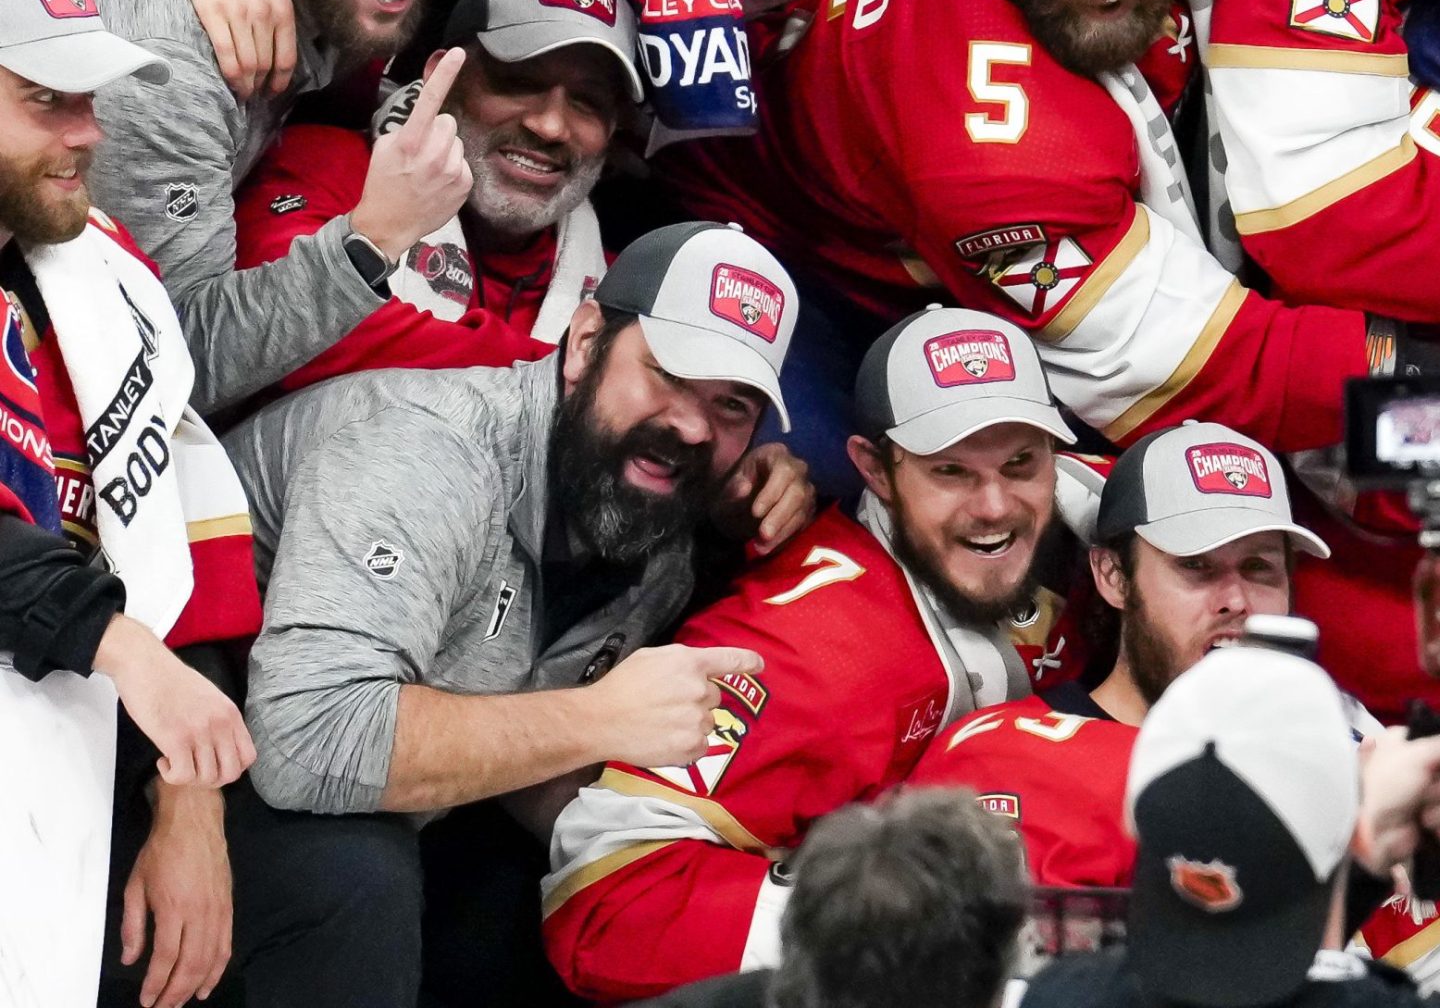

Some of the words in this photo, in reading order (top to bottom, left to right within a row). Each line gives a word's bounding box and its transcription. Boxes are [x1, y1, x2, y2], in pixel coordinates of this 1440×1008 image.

[965, 39, 1032, 144] 5
[966, 228, 1033, 253] FLORIDA
[715, 276, 780, 326] CHAMPIONS
[931, 342, 1009, 372] CHAMPIONS
[88, 366, 147, 466] TANLEY
[1194, 454, 1266, 482] CHAMPIONS
[763, 545, 866, 605] 7
[723, 673, 757, 702] RIDA
